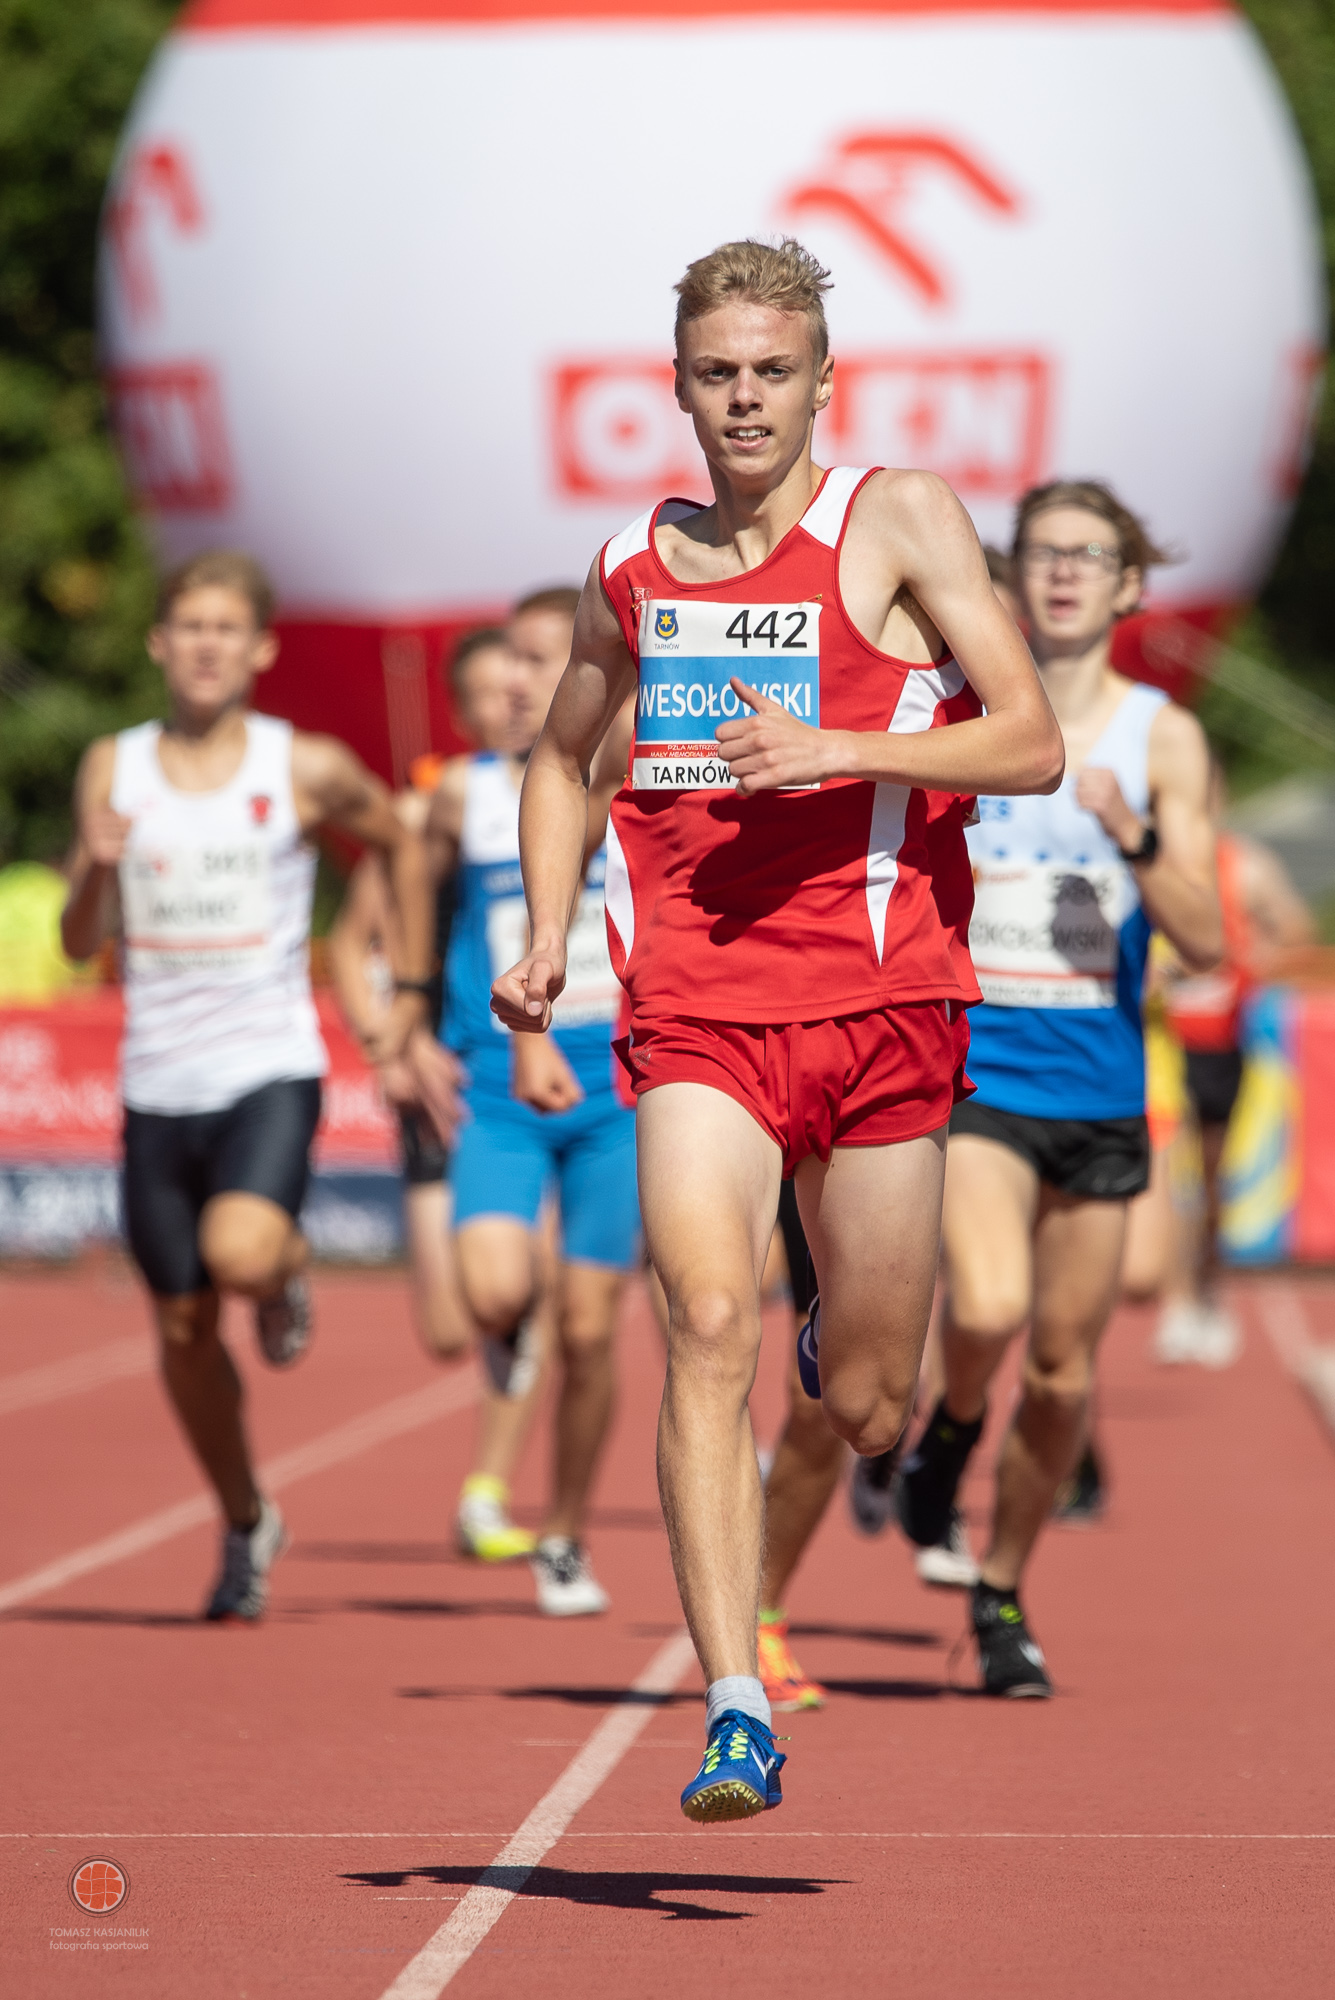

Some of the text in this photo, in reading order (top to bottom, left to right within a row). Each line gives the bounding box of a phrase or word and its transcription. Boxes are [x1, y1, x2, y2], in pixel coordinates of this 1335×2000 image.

[569, 368, 1030, 484] OLEN
[726, 610, 808, 649] 442
[654, 642, 680, 650] TARNÓW
[652, 760, 732, 784] TARNÓW
